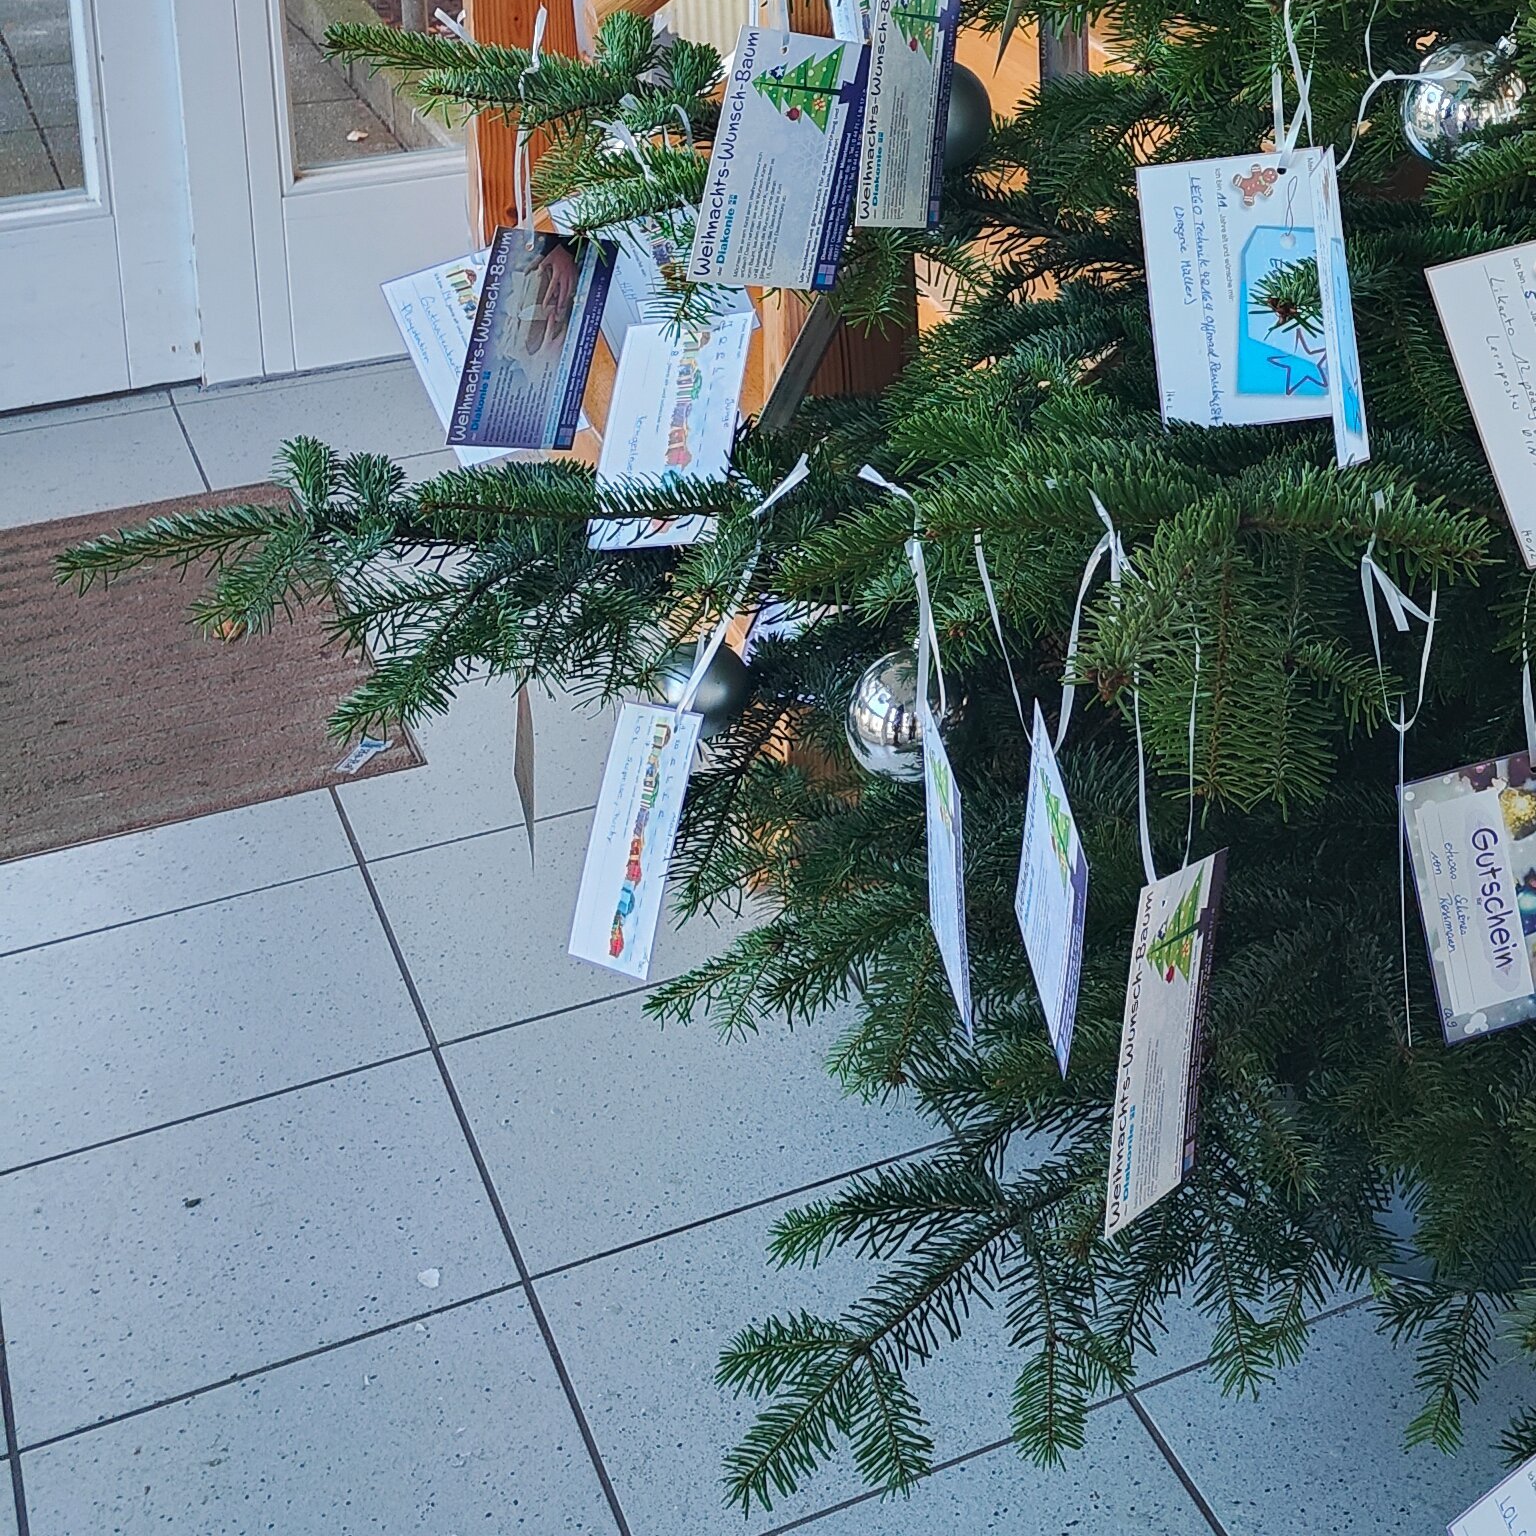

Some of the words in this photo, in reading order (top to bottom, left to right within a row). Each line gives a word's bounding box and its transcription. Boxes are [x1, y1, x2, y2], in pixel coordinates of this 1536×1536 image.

[692, 31, 759, 275] Weihnachts-Wunsch-Baum
[871, 146, 882, 207] Diakonie
[1189, 176, 1203, 215] LEGO
[715, 207, 735, 264] Diakonie
[1511, 257, 1523, 270] Ich
[1515, 270, 1527, 284] bin
[449, 230, 512, 441] Weihnachts-Wunsch-Baum
[1471, 827, 1517, 968] Gutschein
[1108, 891, 1153, 1228] Weihnachts-Wunsch-Baum
[1123, 1123, 1134, 1201] Diakonie
